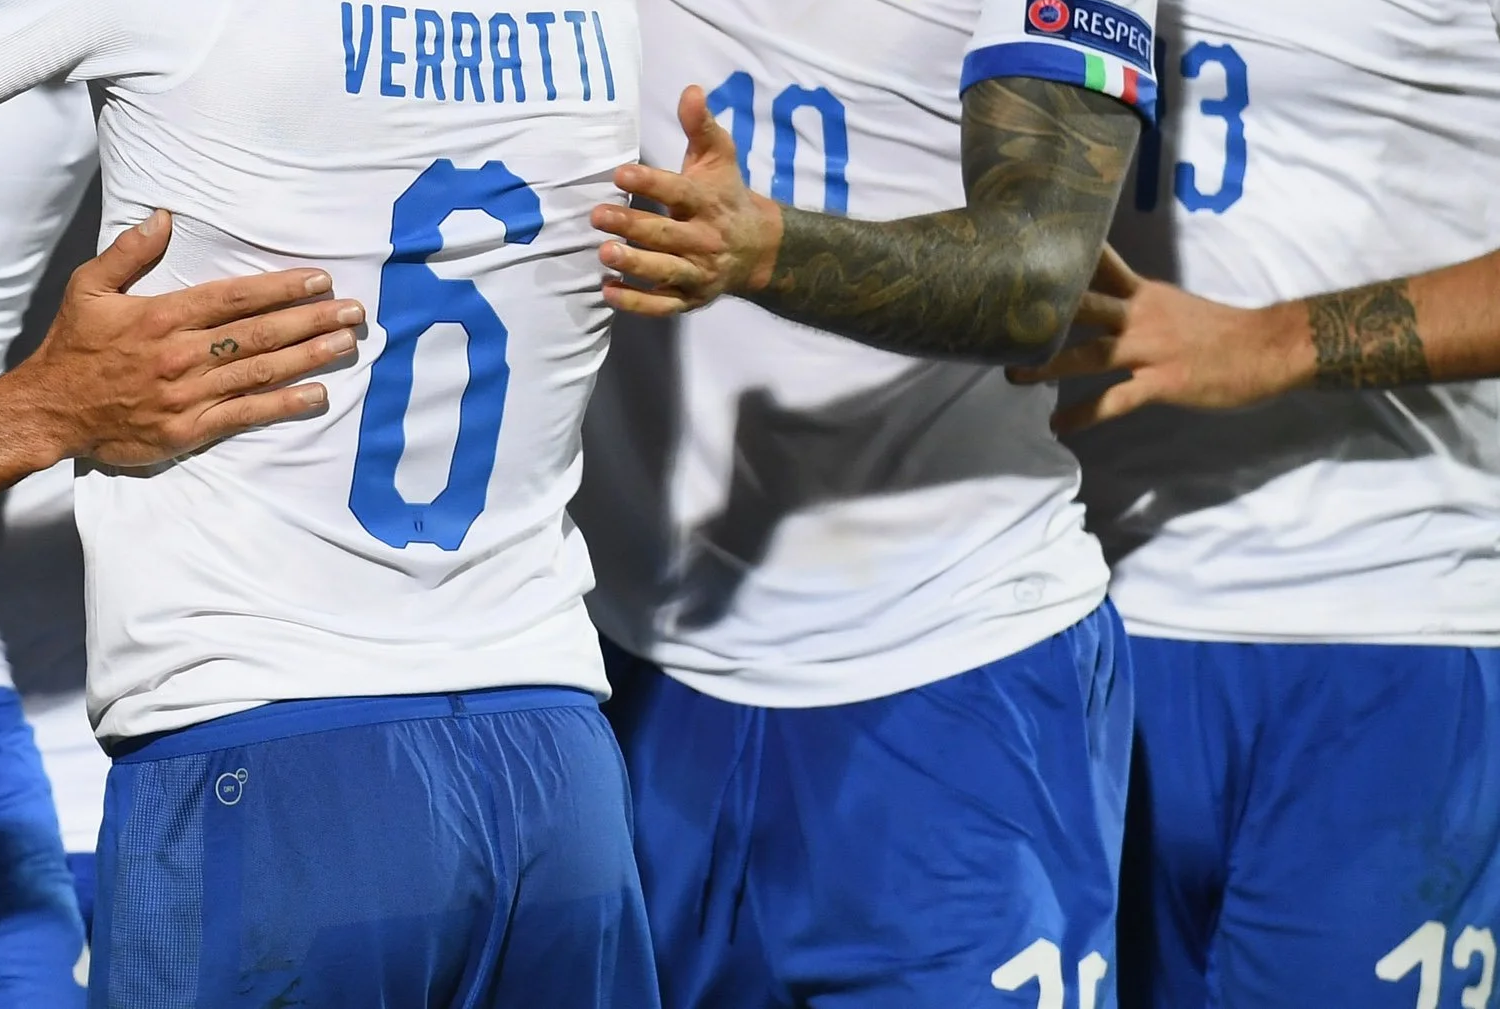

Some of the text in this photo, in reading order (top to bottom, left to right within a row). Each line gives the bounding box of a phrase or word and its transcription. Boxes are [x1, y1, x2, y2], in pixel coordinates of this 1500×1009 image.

[340, 1, 617, 103] VERRATTI
[1073, 7, 1151, 60] RESPECT
[706, 68, 850, 218] 10
[348, 158, 545, 552] 6
